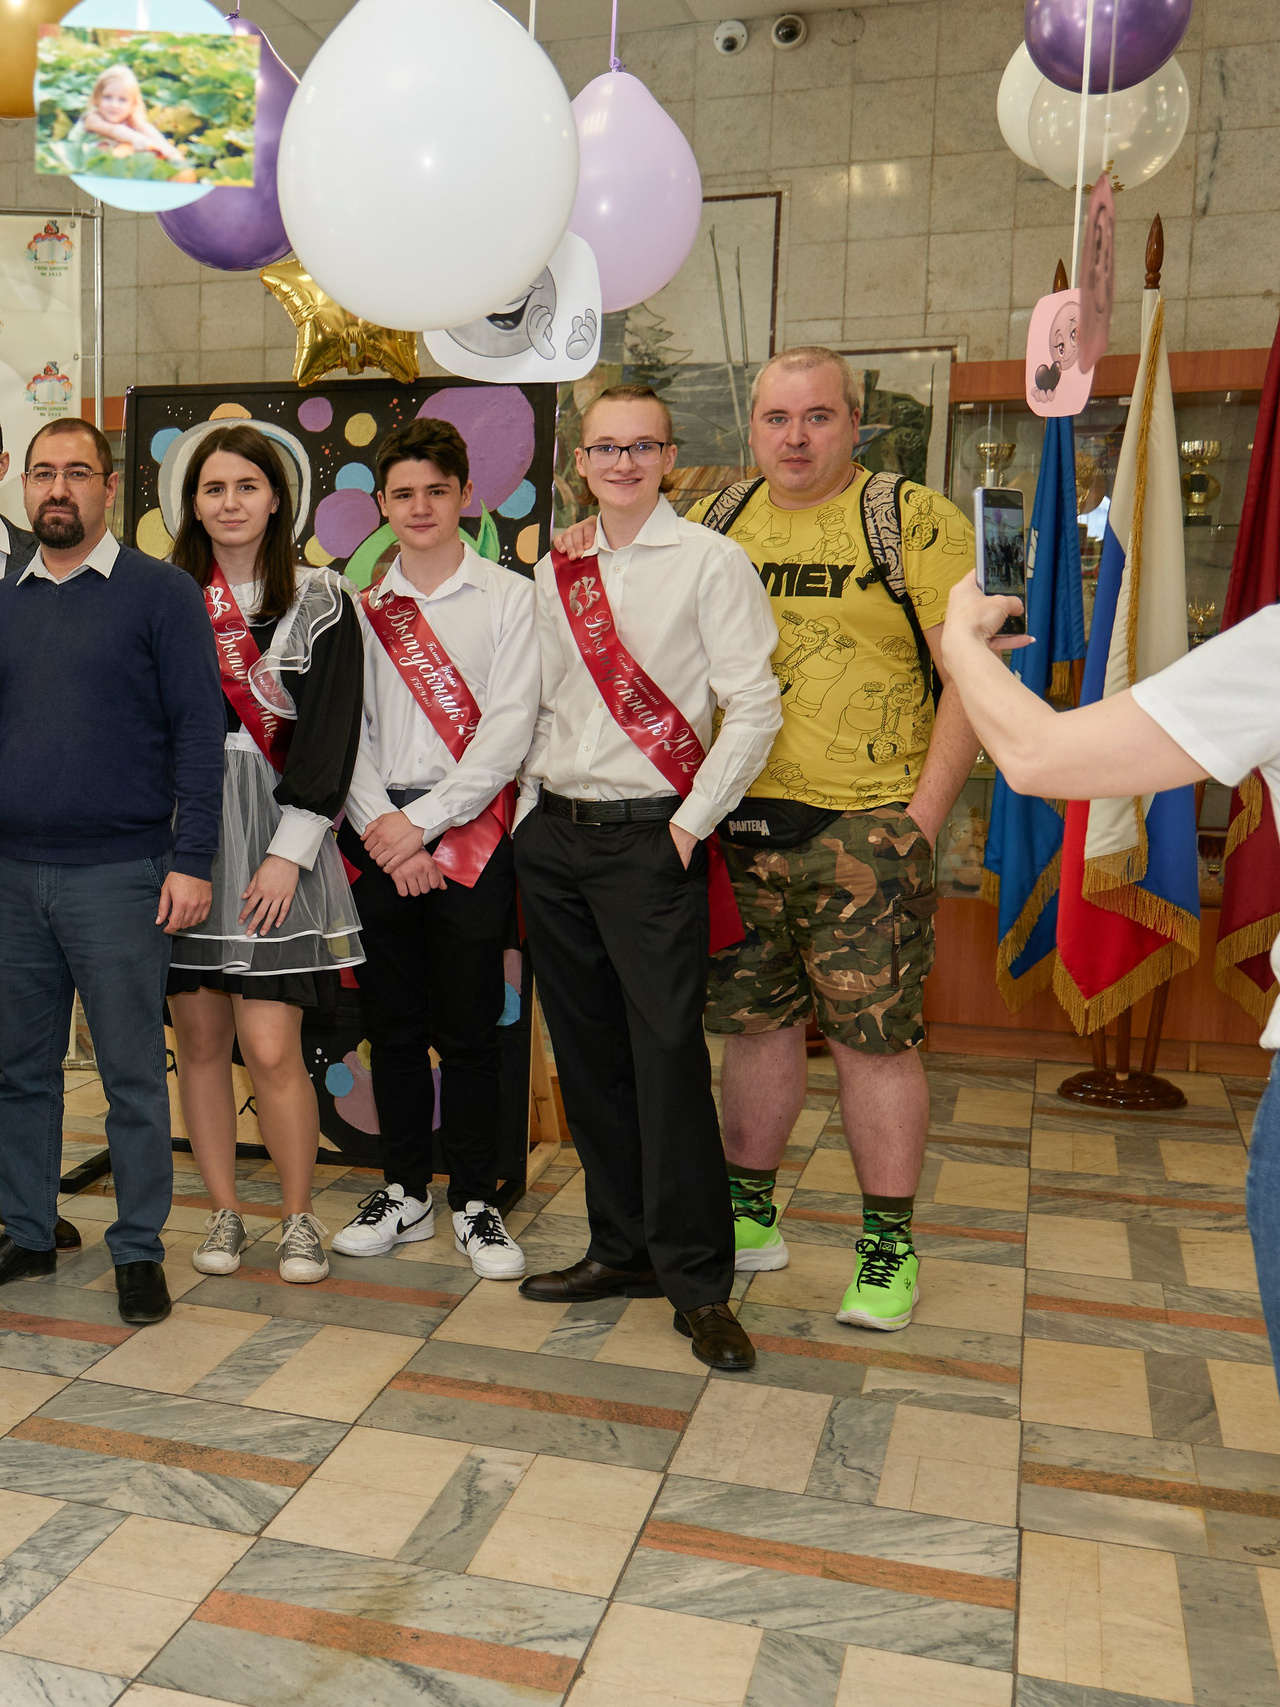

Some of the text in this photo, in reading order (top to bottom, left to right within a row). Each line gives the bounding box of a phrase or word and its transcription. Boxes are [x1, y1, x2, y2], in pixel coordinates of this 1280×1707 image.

[752, 562, 856, 598] MEY
[385, 602, 480, 745] Выпускник 20
[426, 641, 457, 688] Галкин Павел
[616, 652, 634, 673] Попов
[584, 610, 705, 774] Выпускник 202
[728, 819, 771, 836] PANTERA
